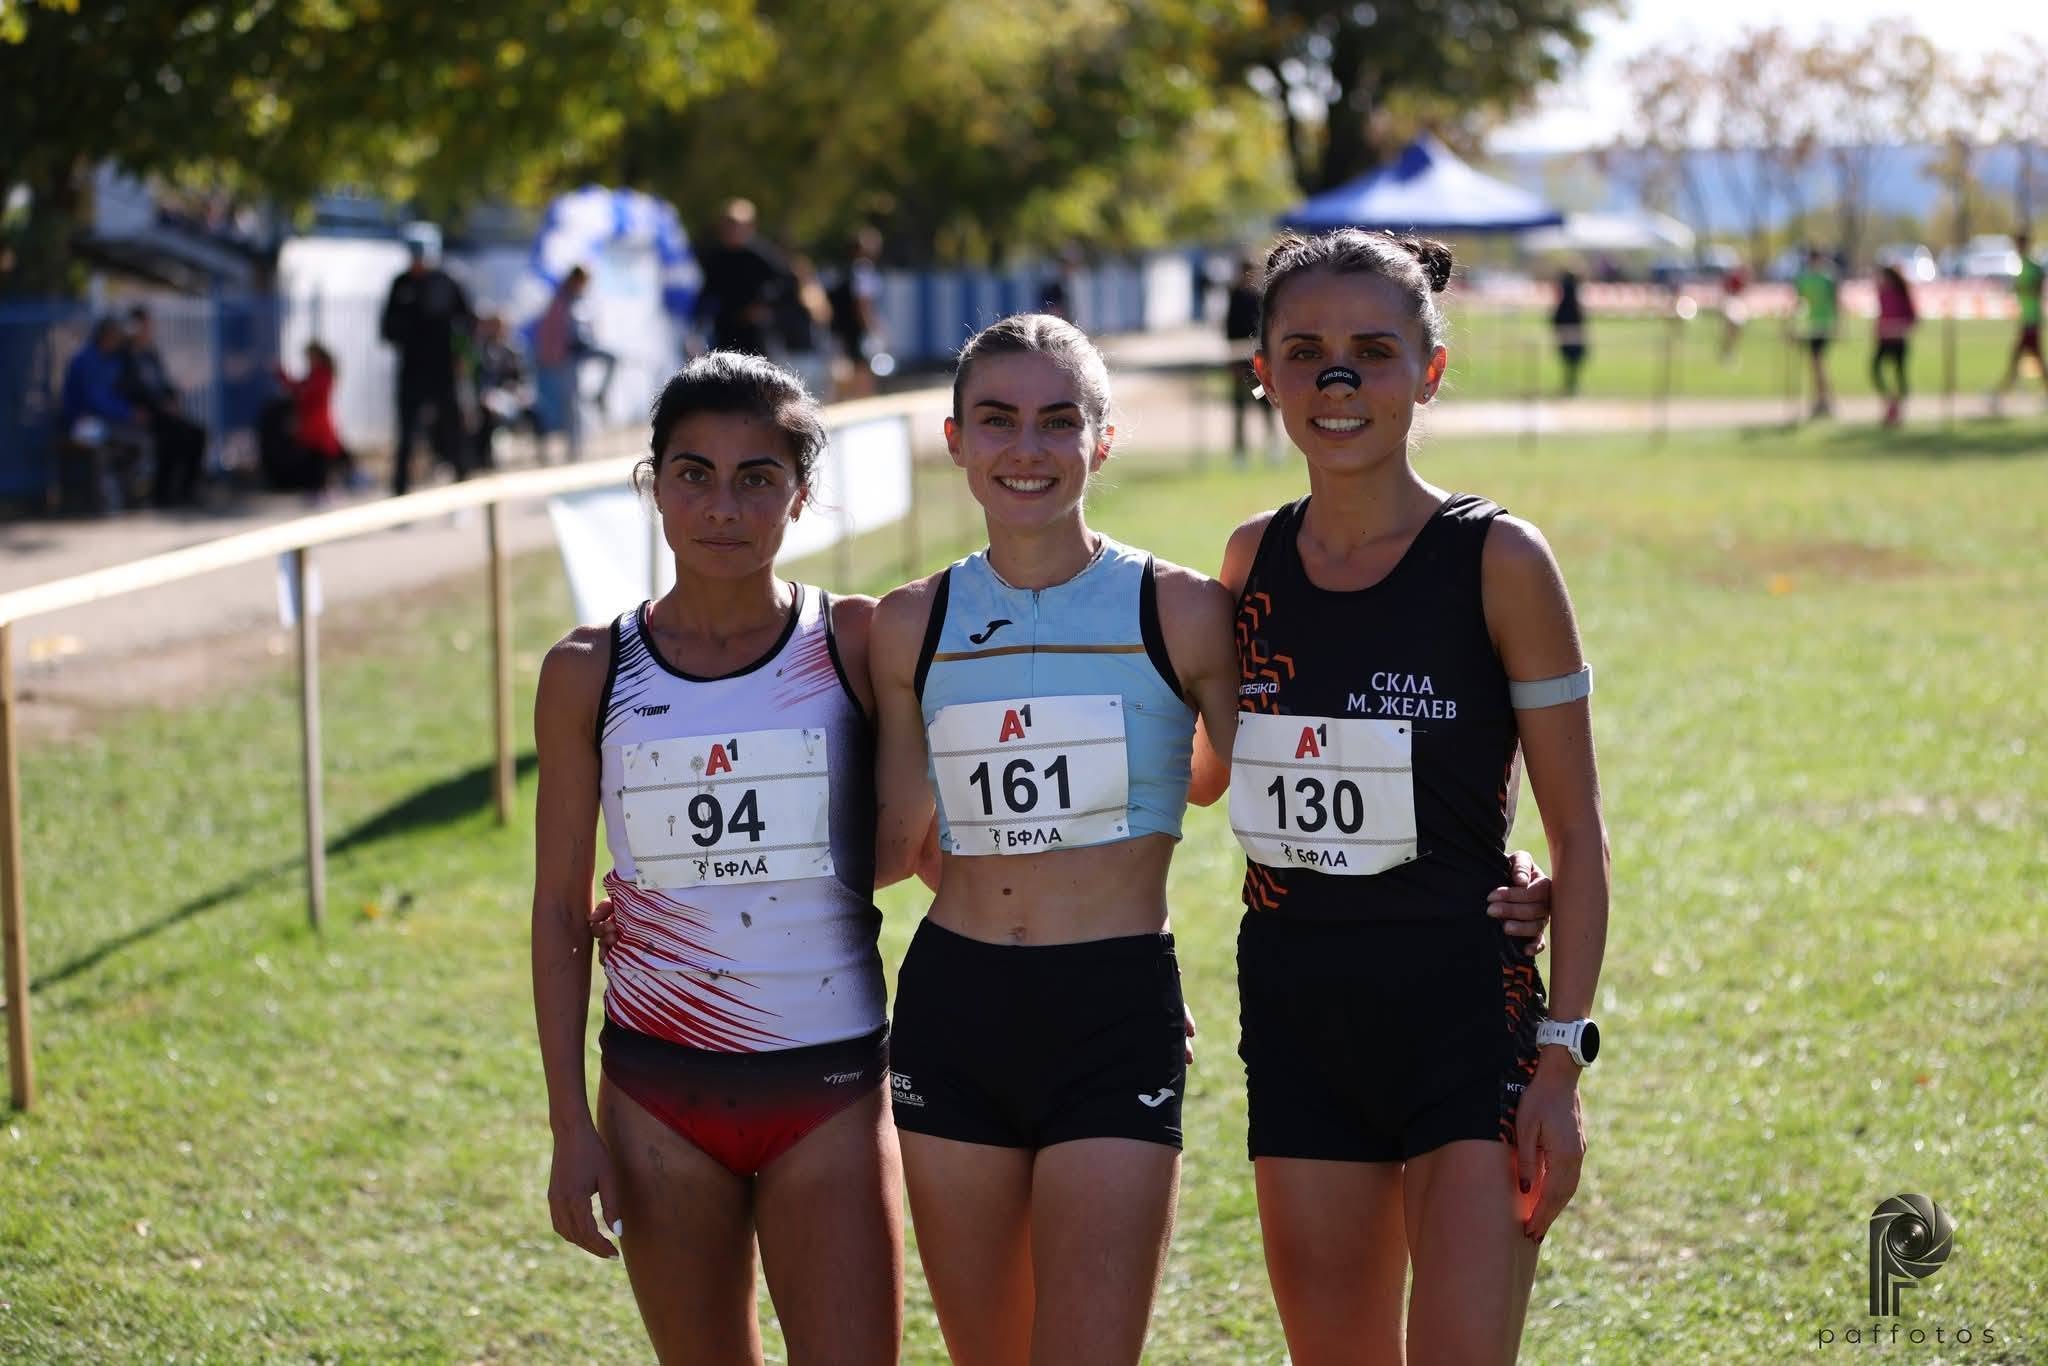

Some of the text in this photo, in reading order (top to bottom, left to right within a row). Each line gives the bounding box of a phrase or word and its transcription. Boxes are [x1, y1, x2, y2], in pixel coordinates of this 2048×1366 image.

[1371, 671, 1434, 695] СКЛА
[641, 704, 671, 717] TOMY
[1346, 692, 1457, 719] М. ЖЕЛЕВ
[969, 755, 1071, 815] 161
[1267, 775, 1364, 834] 130
[688, 789, 765, 847] 94
[1007, 827, 1062, 847] БФЛА
[714, 858, 768, 878] БФЛА
[1296, 849, 1348, 867] БФЛА
